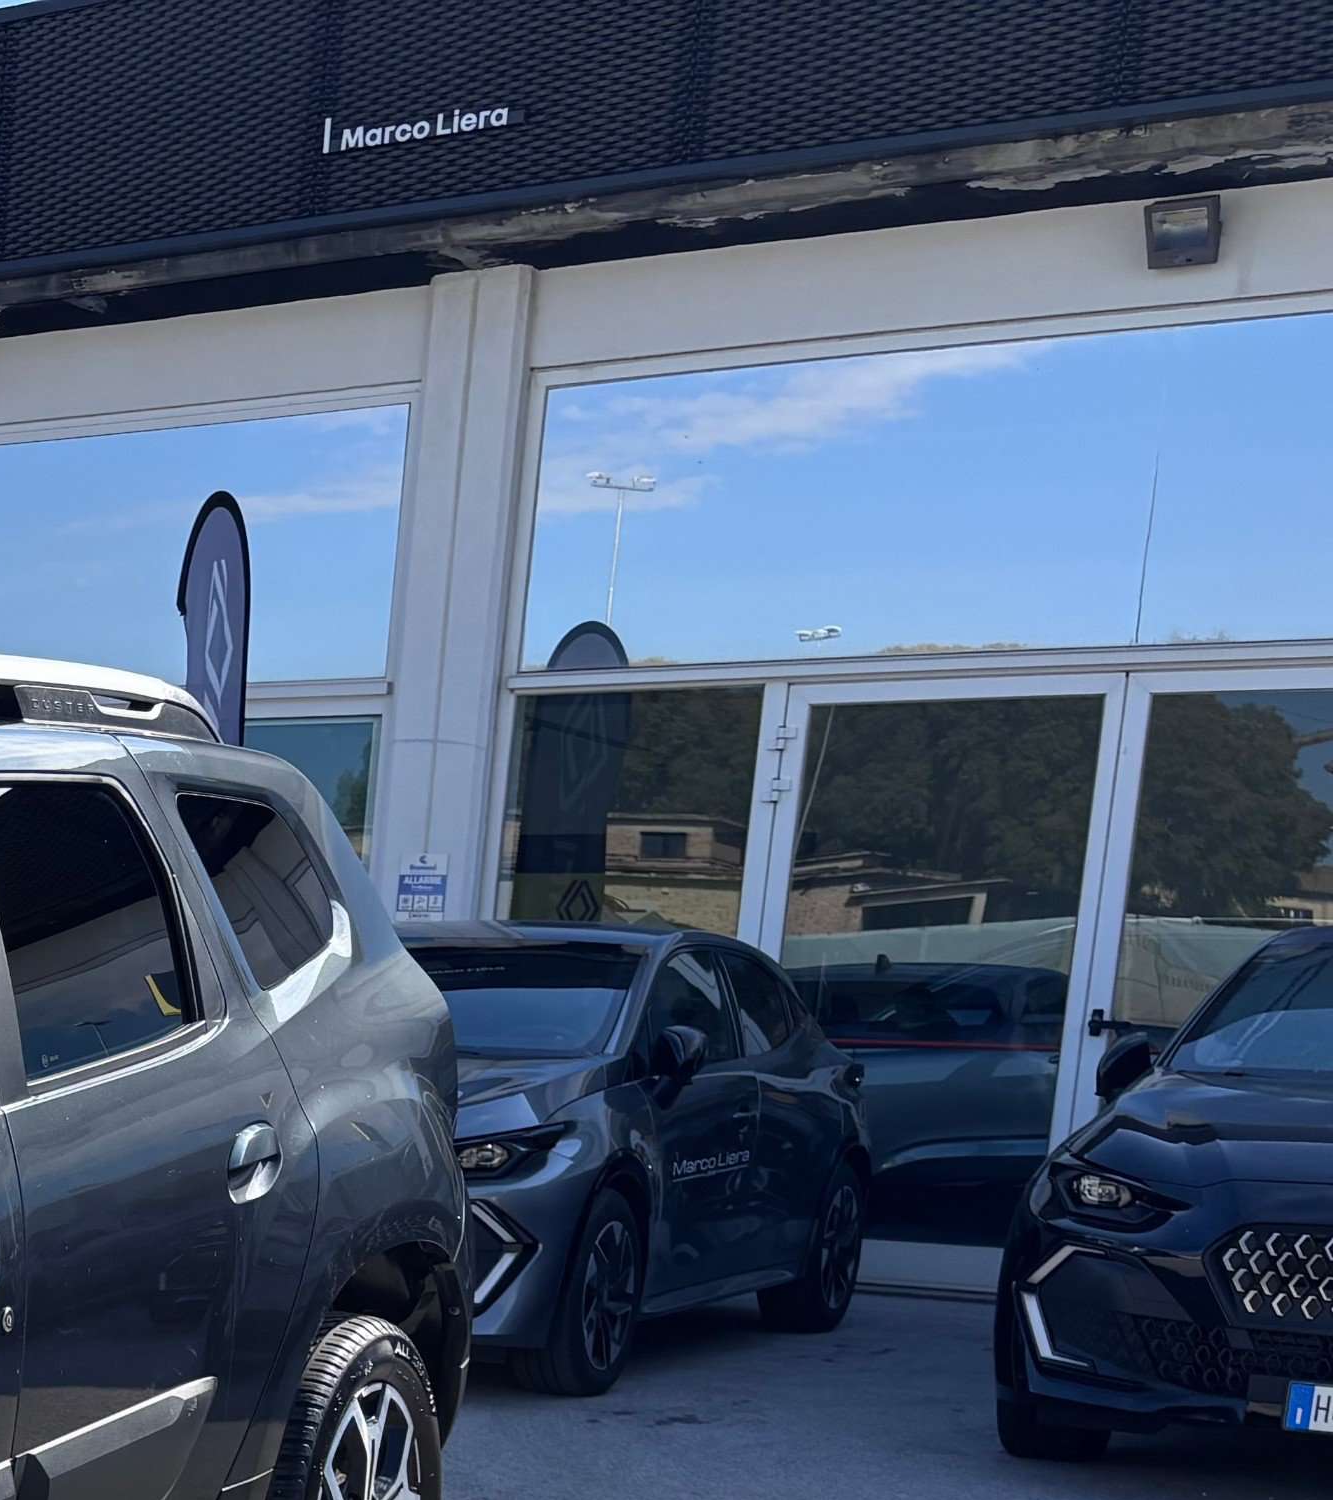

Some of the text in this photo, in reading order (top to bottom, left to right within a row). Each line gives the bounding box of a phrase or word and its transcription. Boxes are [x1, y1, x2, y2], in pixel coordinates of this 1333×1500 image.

[340, 107, 509, 150] Marco Liera
[672, 1150, 750, 1176] Marco Liera
[1314, 1394, 1333, 1423] H
